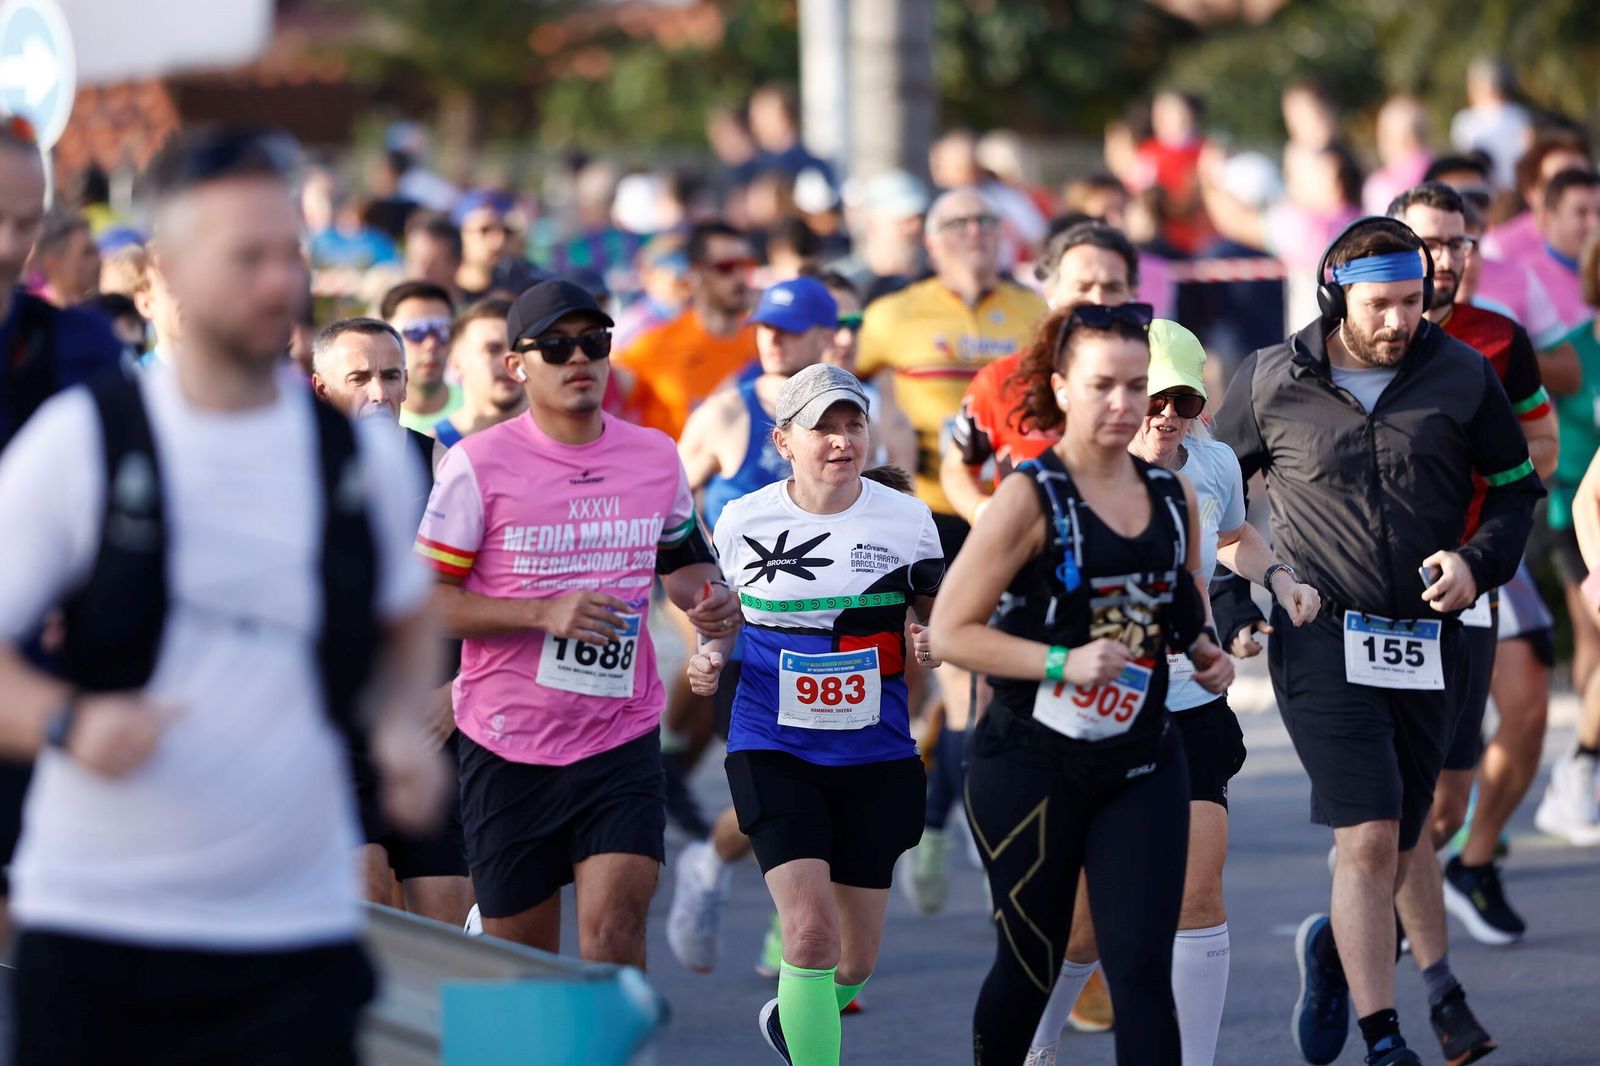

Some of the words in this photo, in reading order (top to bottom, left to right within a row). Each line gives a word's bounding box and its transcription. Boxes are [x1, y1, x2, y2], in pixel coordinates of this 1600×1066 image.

[568, 496, 620, 519] XXXVI
[503, 525, 575, 552] MEDIA
[579, 513, 664, 548] MARATÓ
[850, 551, 872, 560] MITJA
[864, 544, 888, 552] eDreams
[513, 553, 629, 574] INTERNACIONAL
[766, 558, 798, 567] BROOKS
[850, 559, 889, 571] BARCELONA
[553, 635, 635, 671] 1688
[1363, 636, 1424, 667] 155
[796, 674, 866, 705] 983
